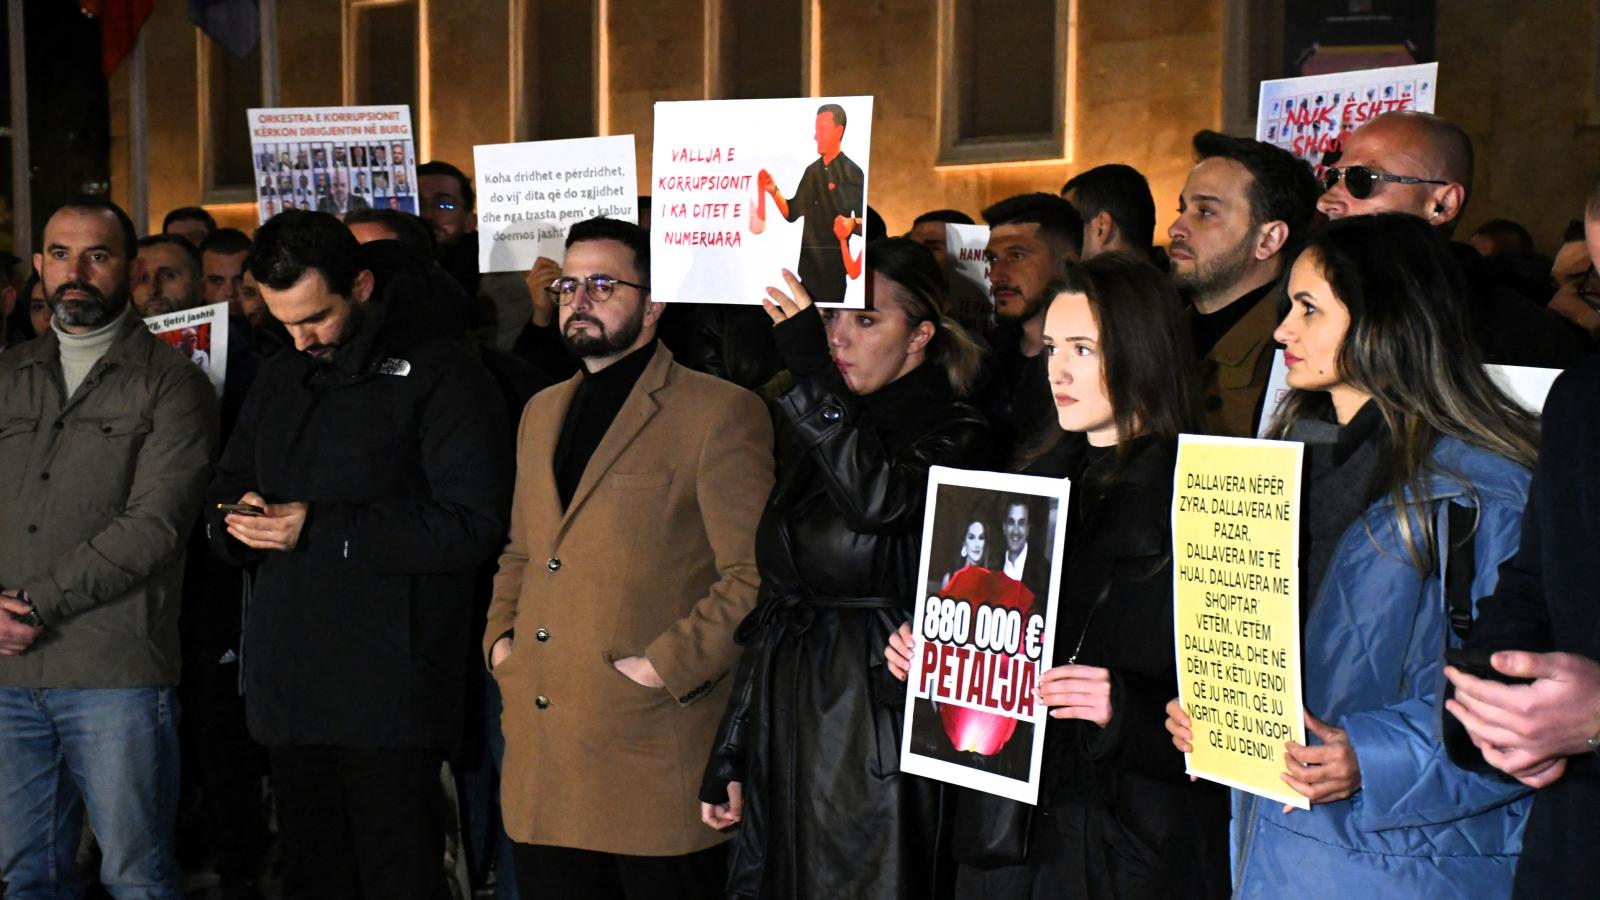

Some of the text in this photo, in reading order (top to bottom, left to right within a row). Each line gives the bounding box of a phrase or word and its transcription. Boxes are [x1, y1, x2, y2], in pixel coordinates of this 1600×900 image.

[258, 111, 400, 123] ORKESTRA E KORRUPSIONIT
[1285, 93, 1413, 128] NUK ËSHTË
[254, 124, 409, 137] KËRKON DIRIGJENTIN NË BURG
[672, 147, 736, 163] VALLJA E
[484, 172, 511, 184] Koha
[514, 170, 552, 182] dridhet
[555, 172, 562, 180] e
[658, 175, 752, 192] KORRUPSIONIT
[490, 193, 504, 203] do
[525, 190, 545, 202] dita
[548, 190, 561, 203] që
[564, 188, 578, 198] do
[580, 186, 624, 201] zgjidhet
[482, 211, 501, 223] dhe
[504, 213, 522, 224] nga
[526, 210, 556, 222] trasta
[588, 208, 595, 217] e
[597, 205, 632, 217] kalbur
[662, 203, 742, 219] I KA DITET E
[493, 230, 535, 242] doemos
[664, 231, 742, 248] NUMERUARA
[164, 314, 186, 327] tjetri
[187, 309, 215, 323] jashtë
[1187, 473, 1284, 495] DALLAVERA NËPËR
[1211, 498, 1272, 519] DALLAVERA
[1275, 500, 1290, 521] NË
[1187, 542, 1281, 569] DALLAVERA ME TË
[1209, 568, 1270, 592] DALLAVERA
[1273, 577, 1289, 595] ME
[923, 595, 1044, 660] 880 000 €
[1235, 619, 1271, 641] VETËM
[1247, 645, 1269, 665] DHE
[1272, 648, 1286, 669] NË
[919, 641, 1036, 717] PETALJA
[1187, 656, 1208, 676] DËM
[1210, 660, 1223, 679] TË
[1254, 671, 1286, 693] VENDI
[1193, 680, 1207, 699] QË
[1209, 685, 1220, 702] JU
[1253, 693, 1268, 714] QË
[1271, 699, 1283, 716] JU
[1225, 710, 1239, 730] QË
[1242, 717, 1253, 733] JU
[1209, 729, 1275, 762] QË JU DENDI!
